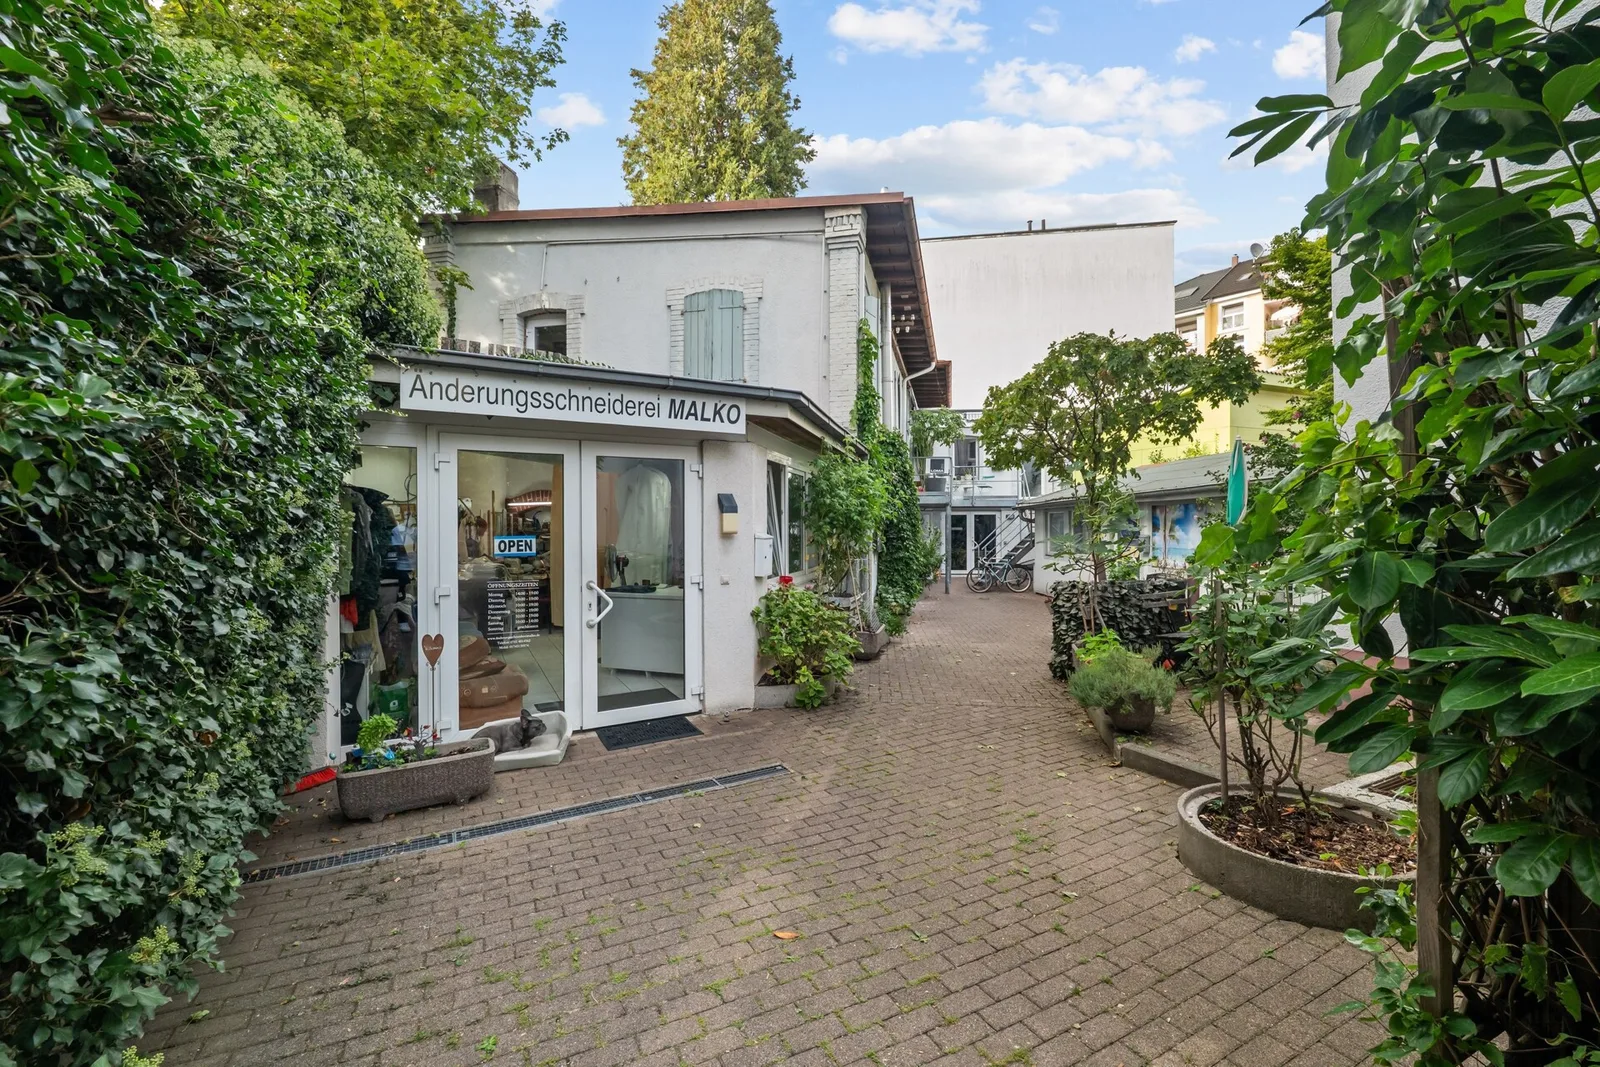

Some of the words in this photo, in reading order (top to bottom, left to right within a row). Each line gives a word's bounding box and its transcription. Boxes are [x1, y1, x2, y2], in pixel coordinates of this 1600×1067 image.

[409, 368, 660, 418] Änderungsschneiderei
[668, 398, 742, 425] MALKO
[498, 539, 533, 553] OPEN
